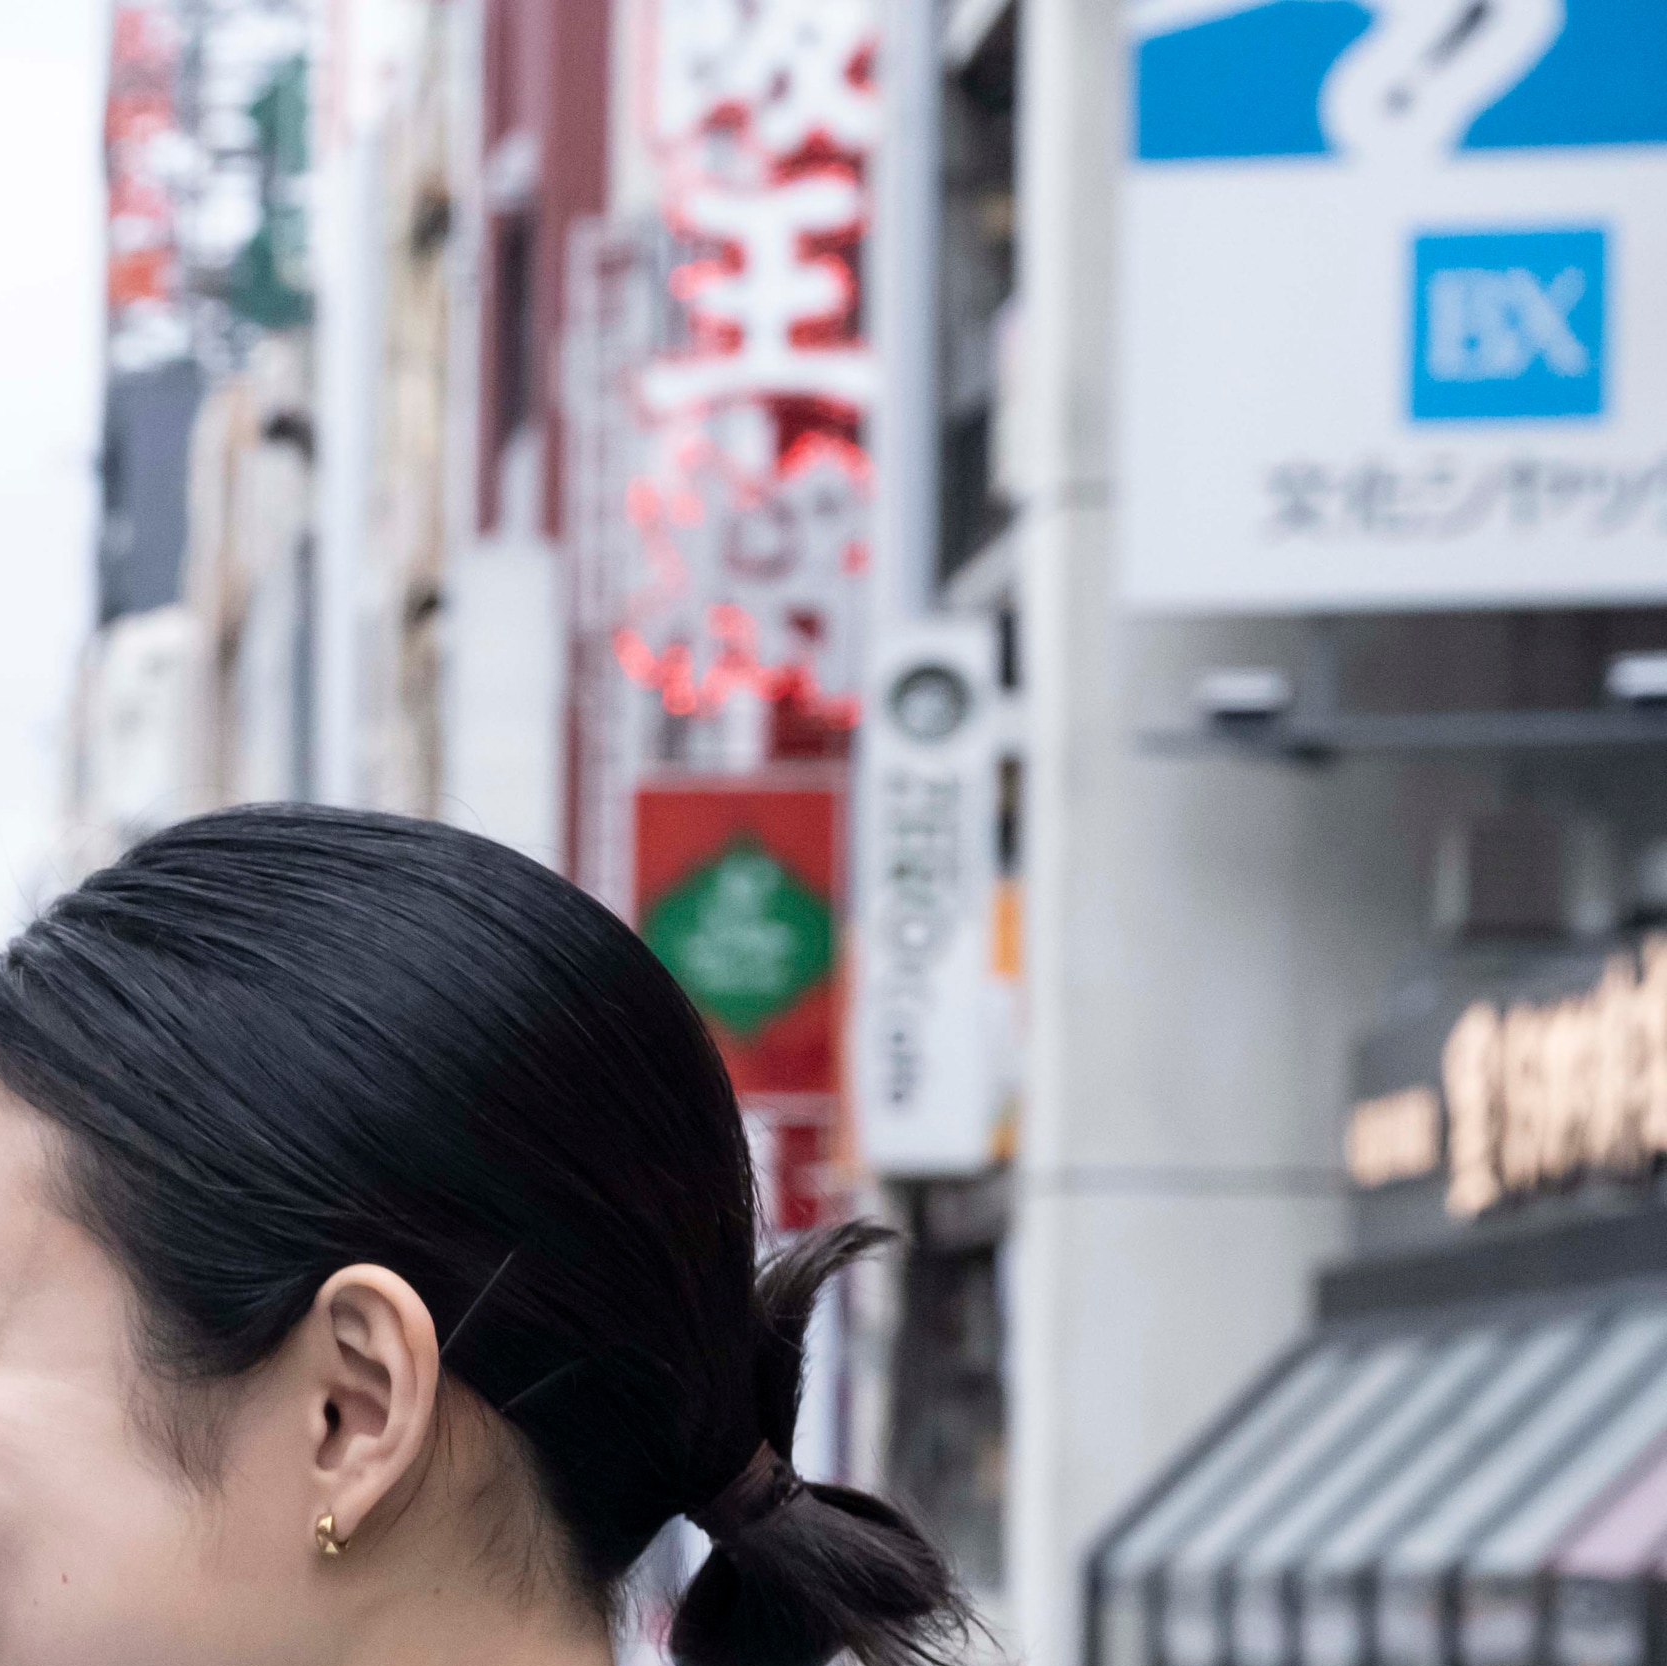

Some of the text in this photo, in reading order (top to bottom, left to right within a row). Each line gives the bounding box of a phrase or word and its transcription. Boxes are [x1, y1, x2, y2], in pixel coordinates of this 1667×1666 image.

[1425, 262, 1591, 384] BX
[1261, 455, 1667, 547] 文化シヤッ
